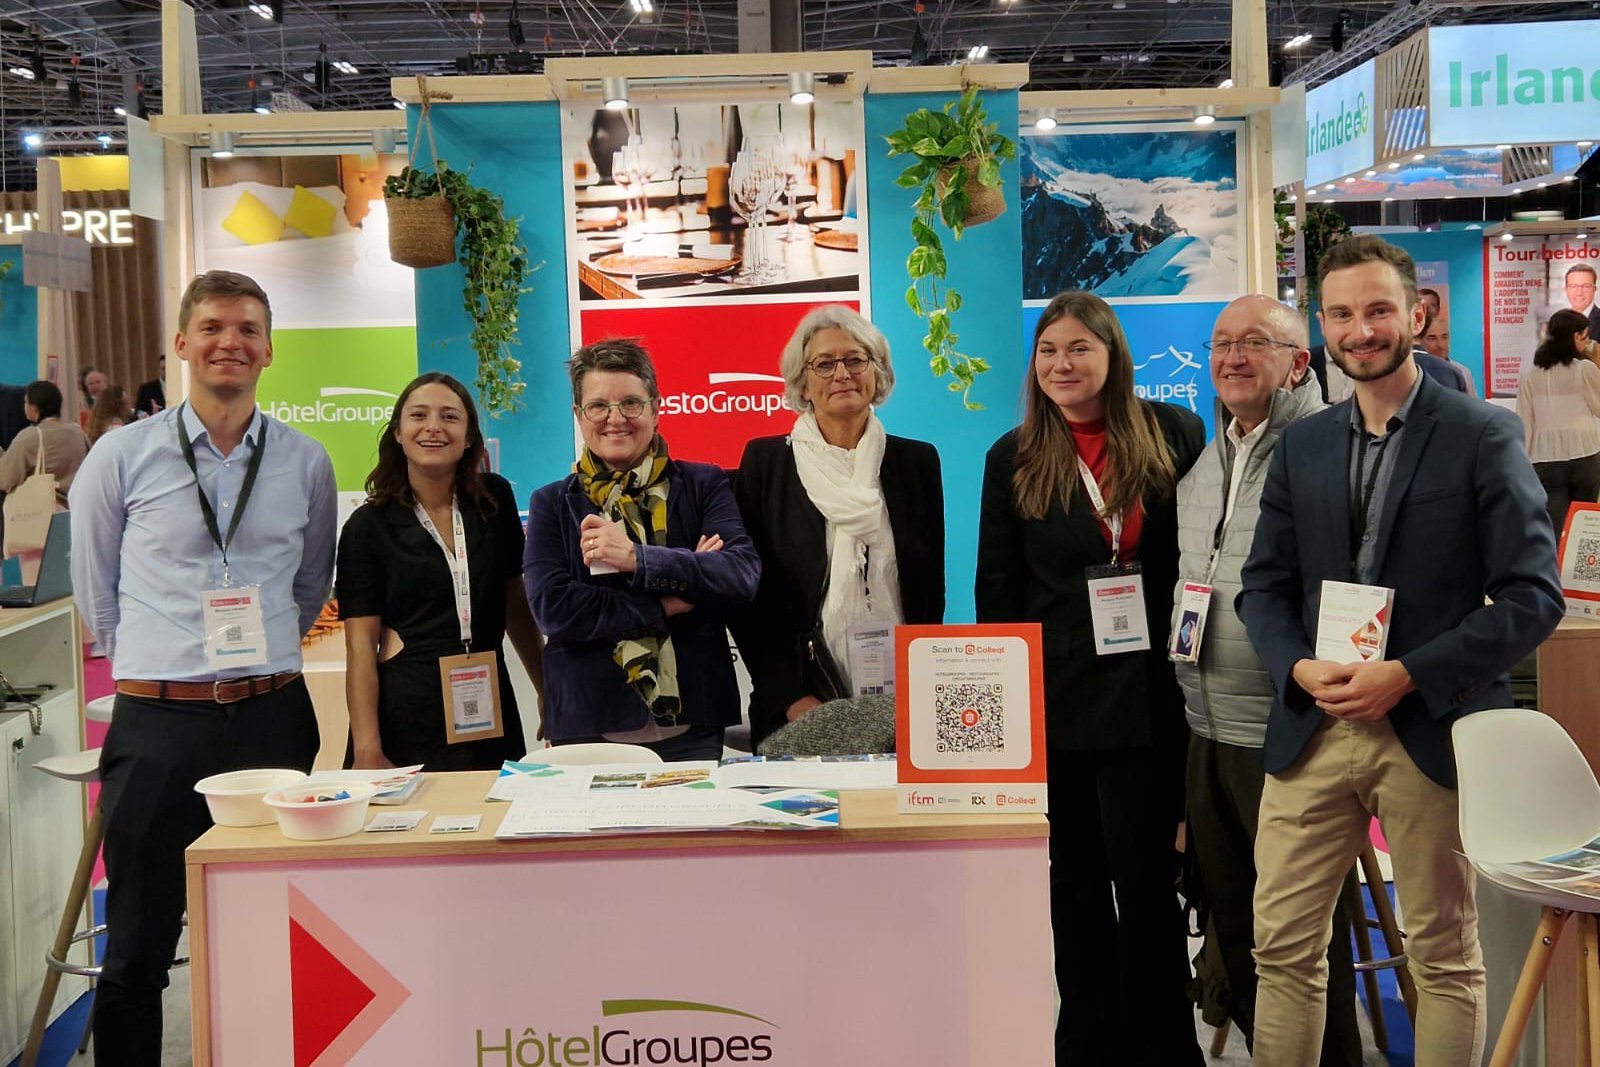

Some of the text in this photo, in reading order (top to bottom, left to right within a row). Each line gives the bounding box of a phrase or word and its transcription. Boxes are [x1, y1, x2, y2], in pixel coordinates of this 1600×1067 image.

[1448, 53, 1600, 108] Irlan
[1494, 241, 1600, 262] Tour hebdo
[658, 391, 794, 416] estoGroupe
[1134, 383, 1198, 402] oupes
[256, 400, 394, 425] HôtelGroupe
[931, 645, 953, 654] Scan
[976, 646, 1005, 656] Colleqt
[907, 791, 935, 806] iftm
[1007, 796, 1037, 806] Colleqt
[476, 1025, 773, 1067] HôtelGroupes
